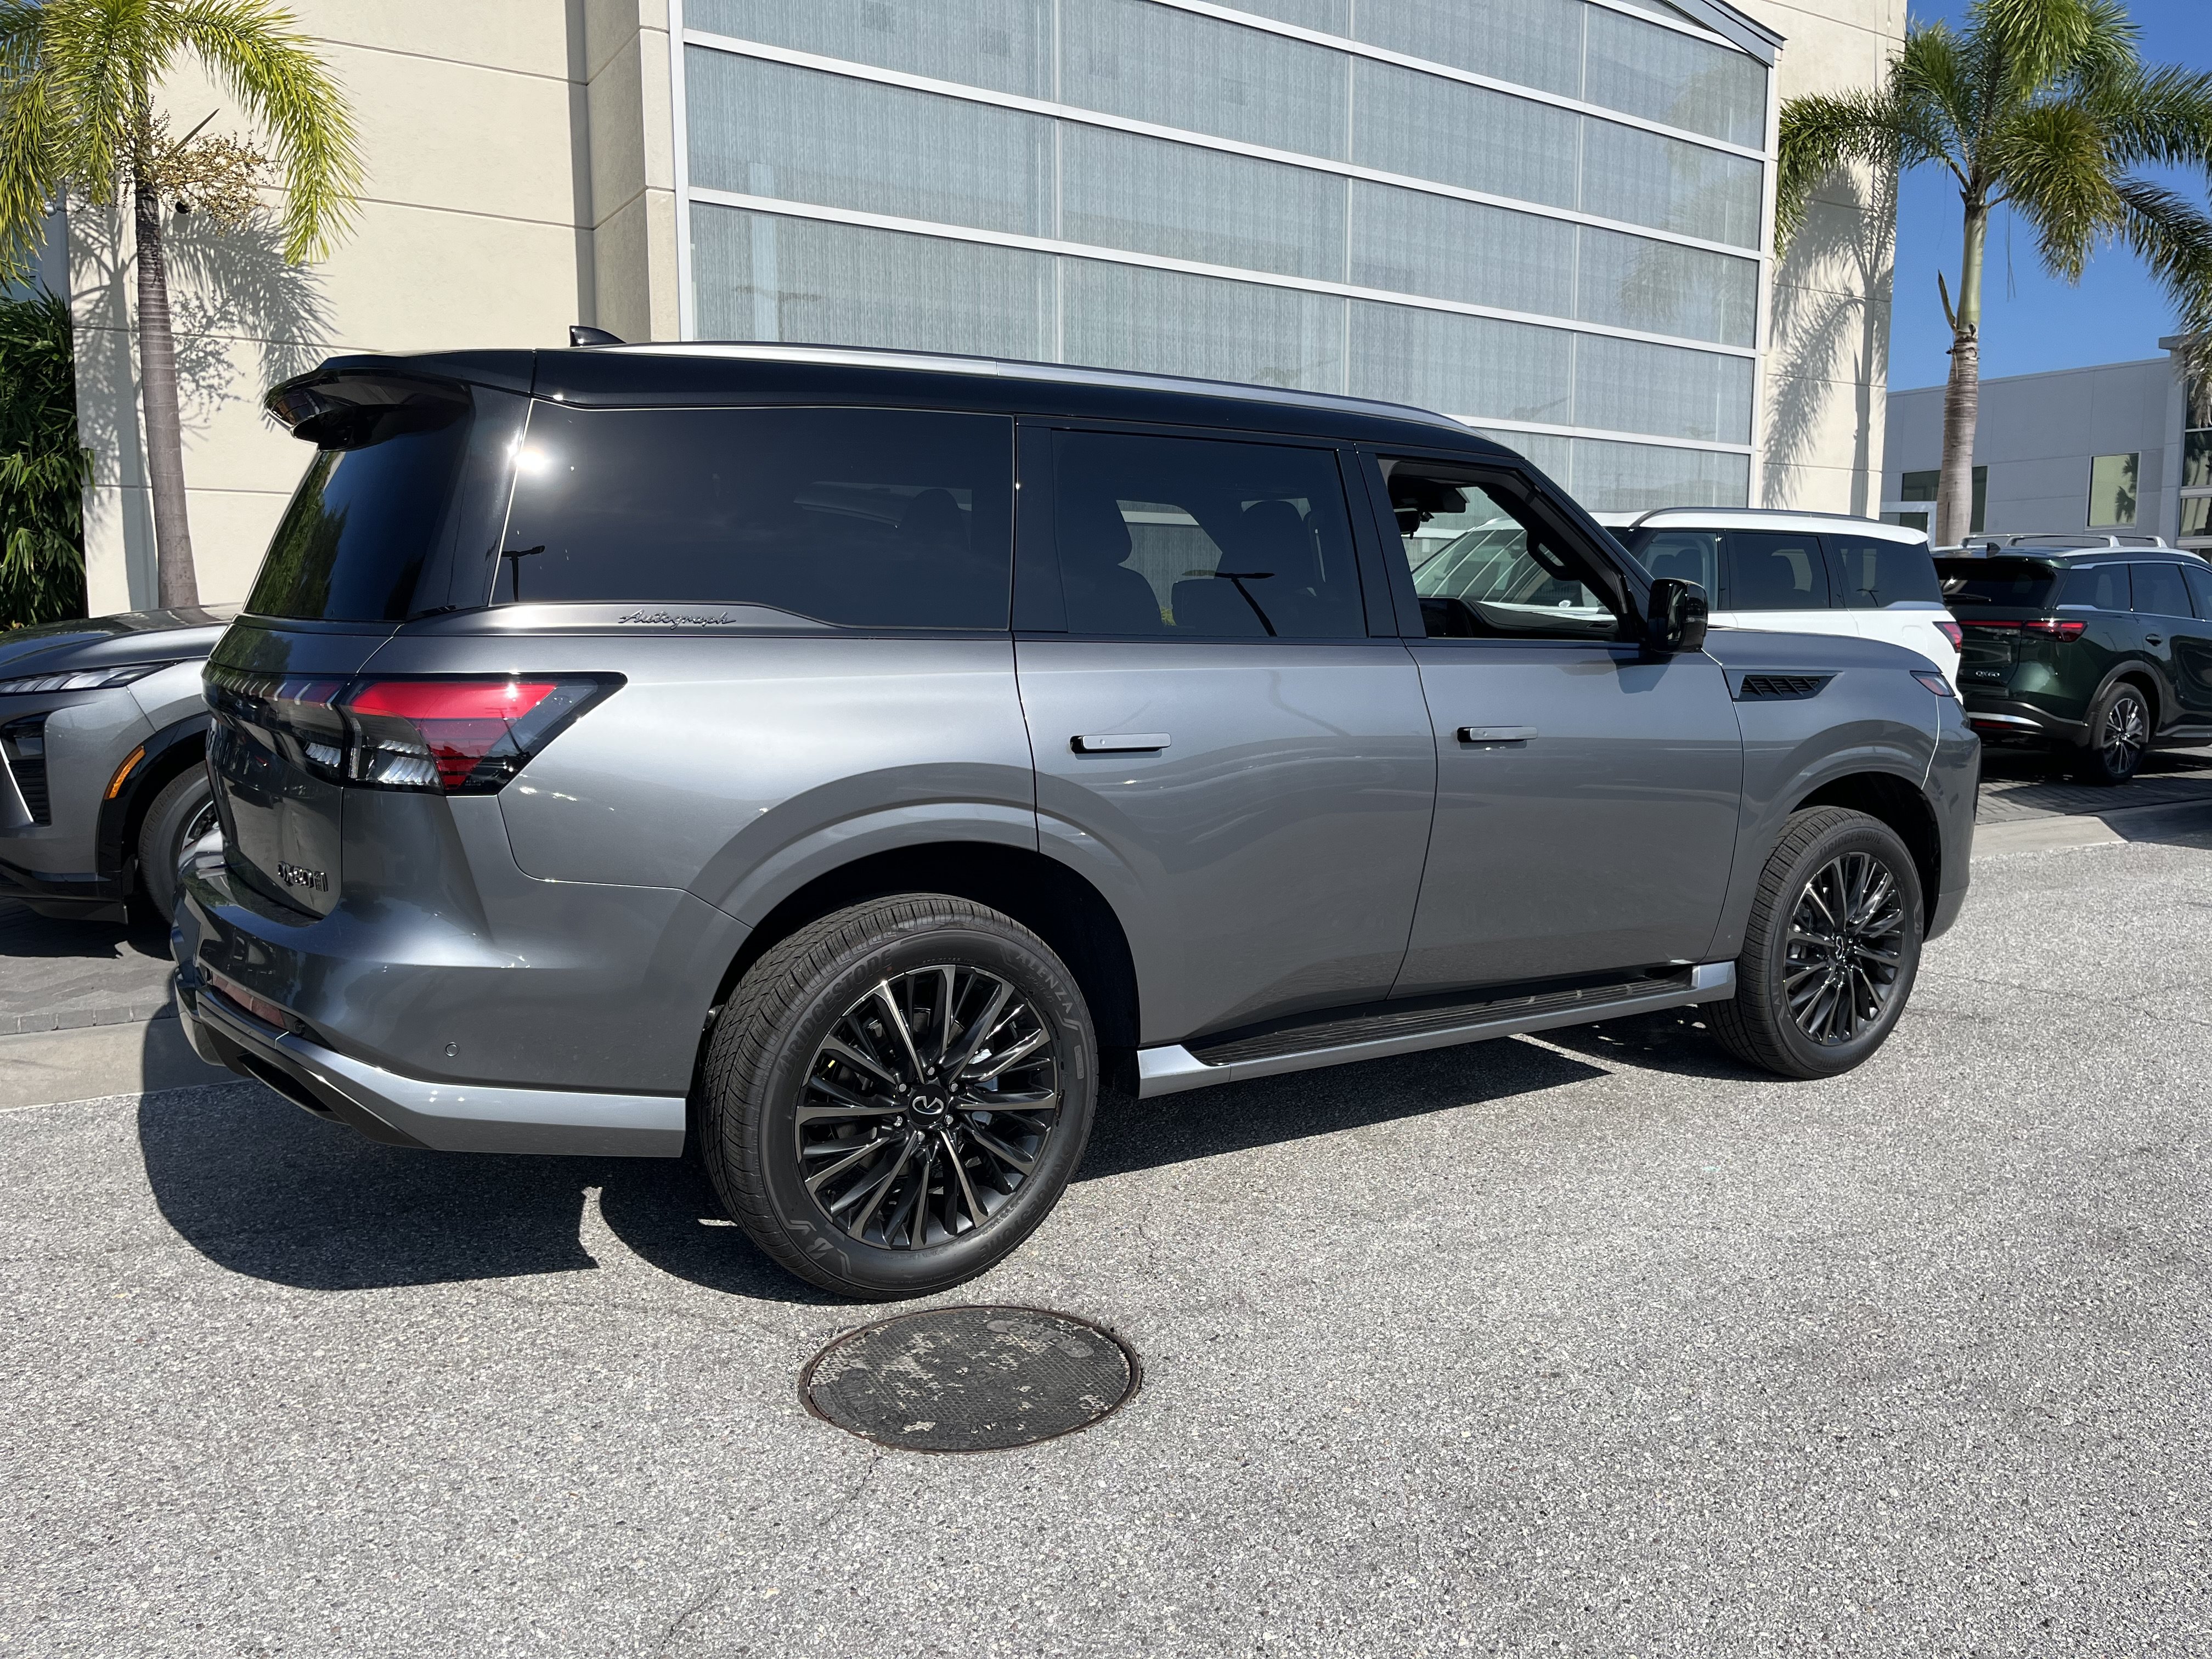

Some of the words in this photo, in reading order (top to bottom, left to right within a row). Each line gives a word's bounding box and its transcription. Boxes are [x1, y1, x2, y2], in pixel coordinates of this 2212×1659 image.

[618, 609, 737, 630] Autograph
[1819, 830, 1884, 860] BRIDGESTONE
[1017, 952, 1074, 1014] ALENZA
[776, 949, 893, 1080] BRIDGESTONE
